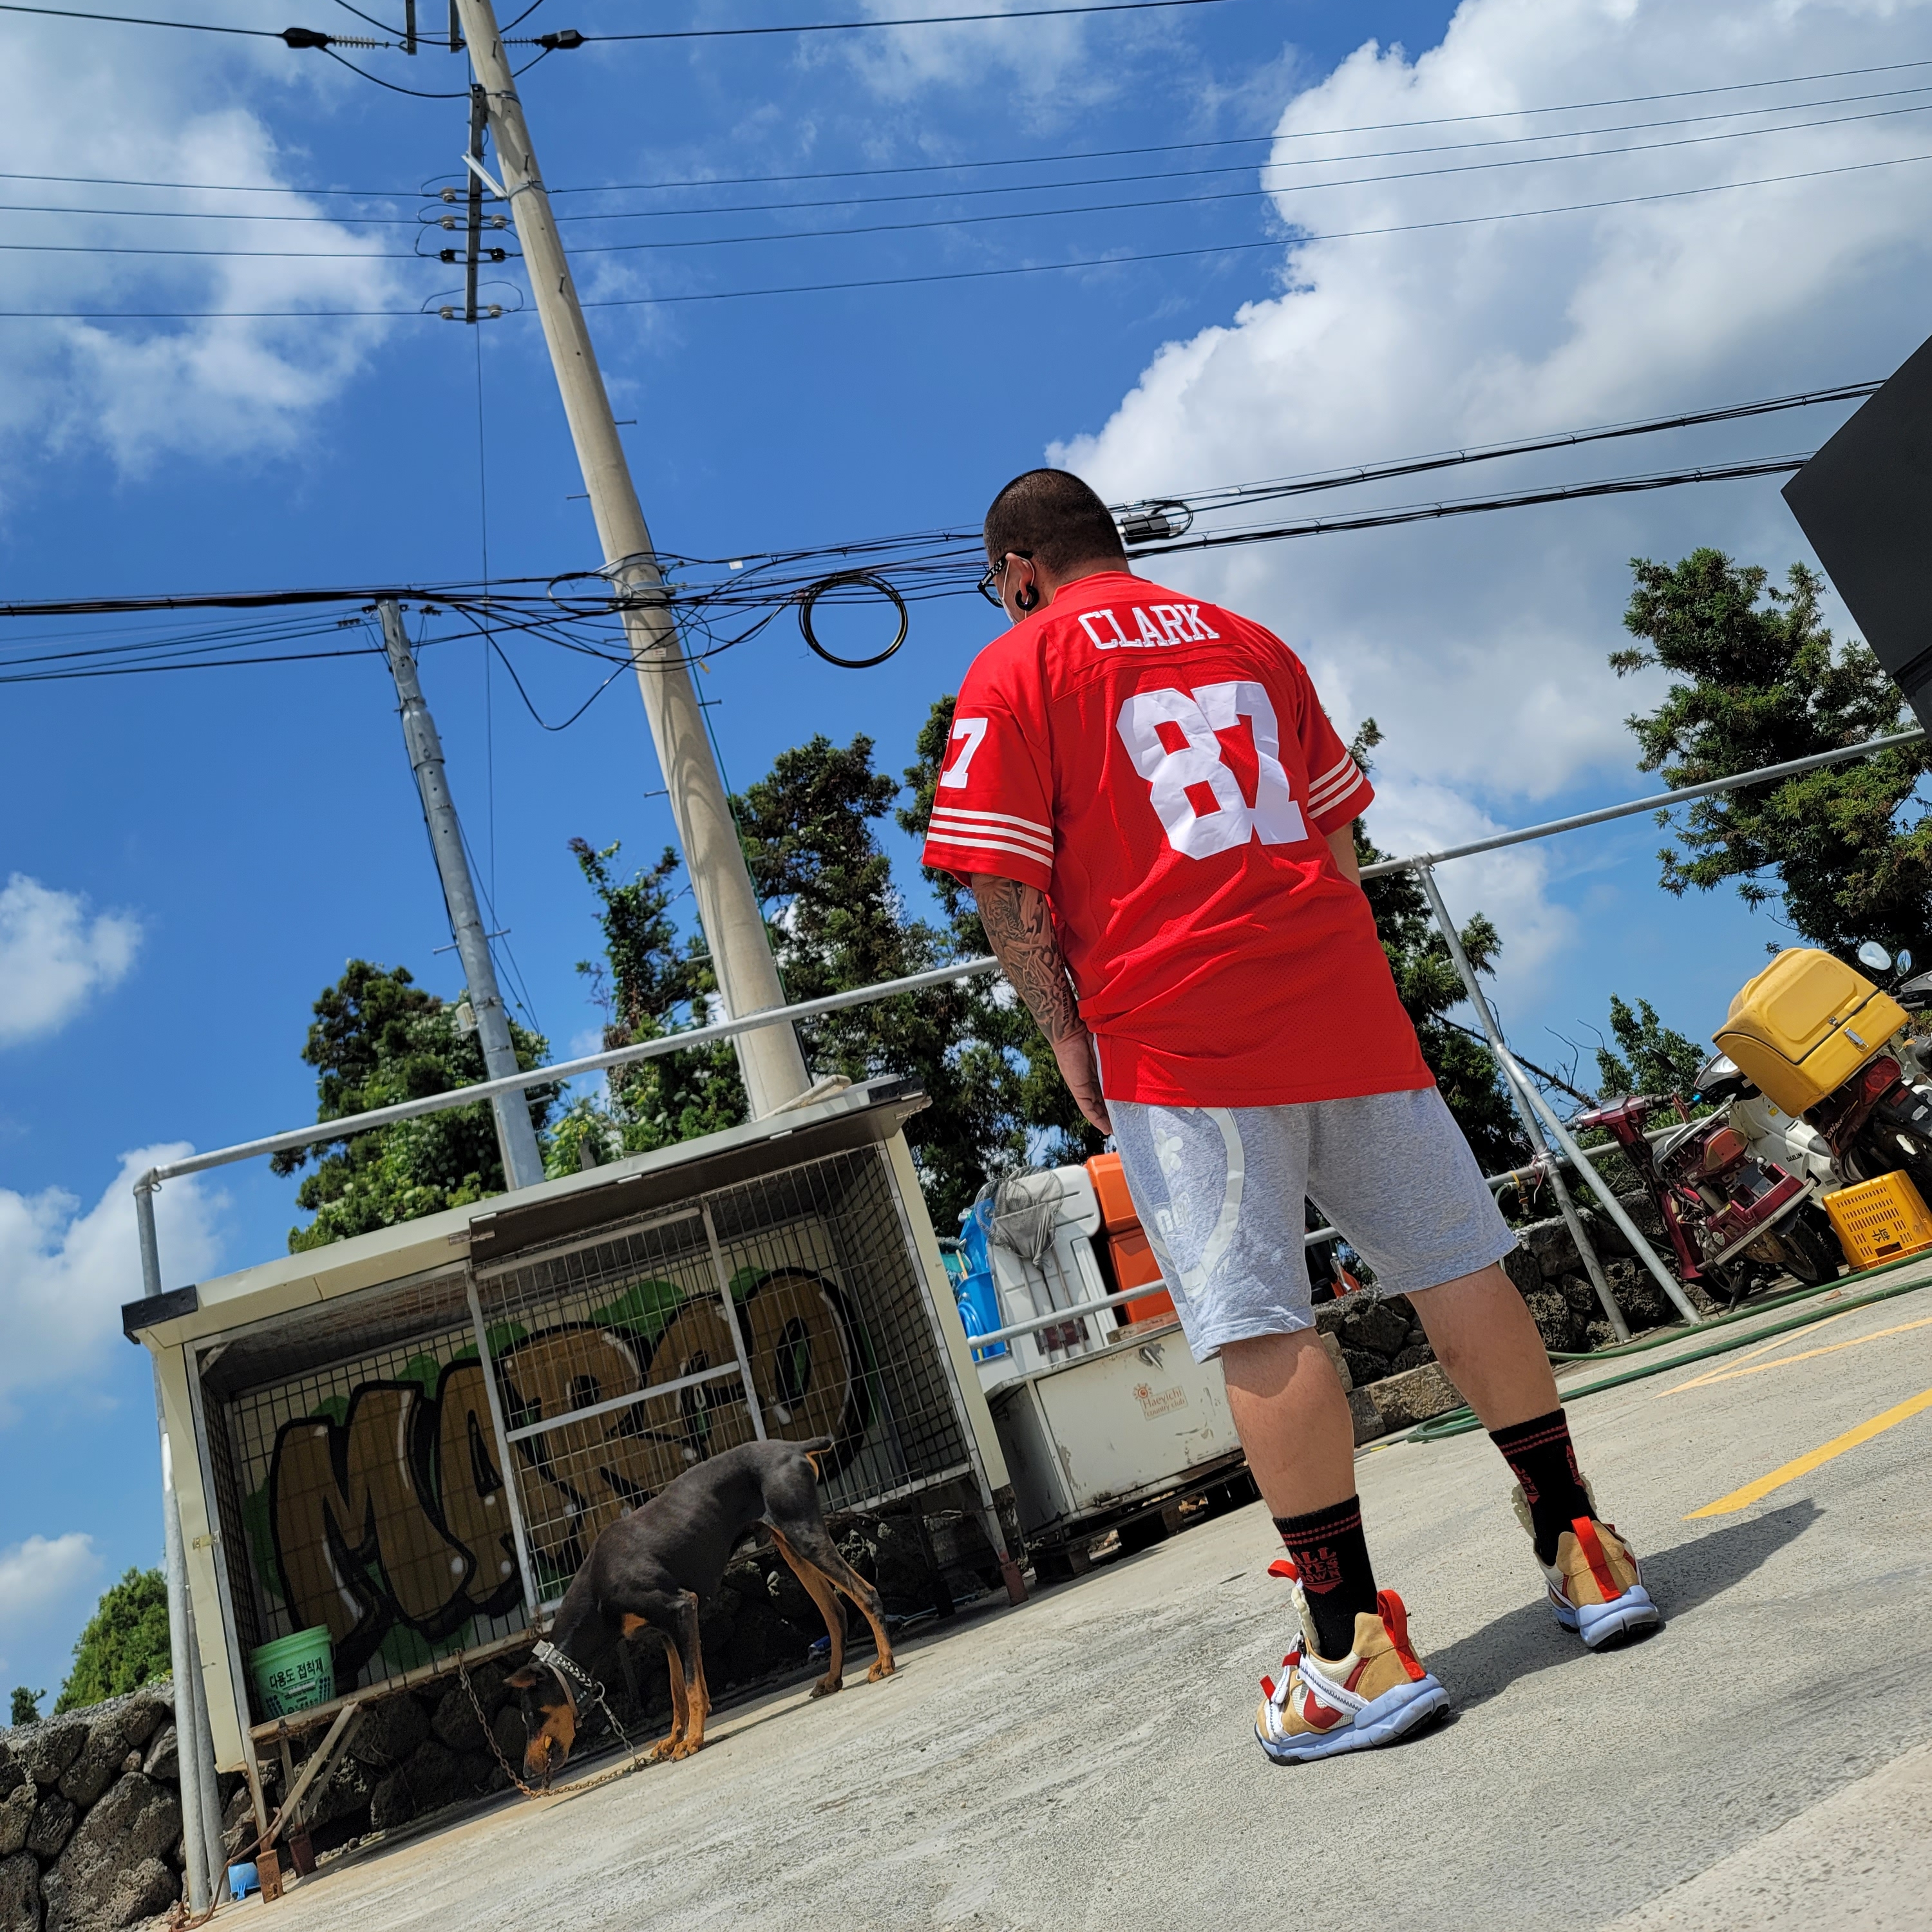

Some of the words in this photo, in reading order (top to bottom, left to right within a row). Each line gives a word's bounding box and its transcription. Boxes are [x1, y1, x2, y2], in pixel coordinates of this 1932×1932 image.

[1077, 604, 1220, 650] CLARK
[940, 717, 988, 789] 7
[1115, 681, 1309, 860] 87
[1292, 1547, 1336, 1564] ALL
[269, 1668, 296, 1690] 다용도
